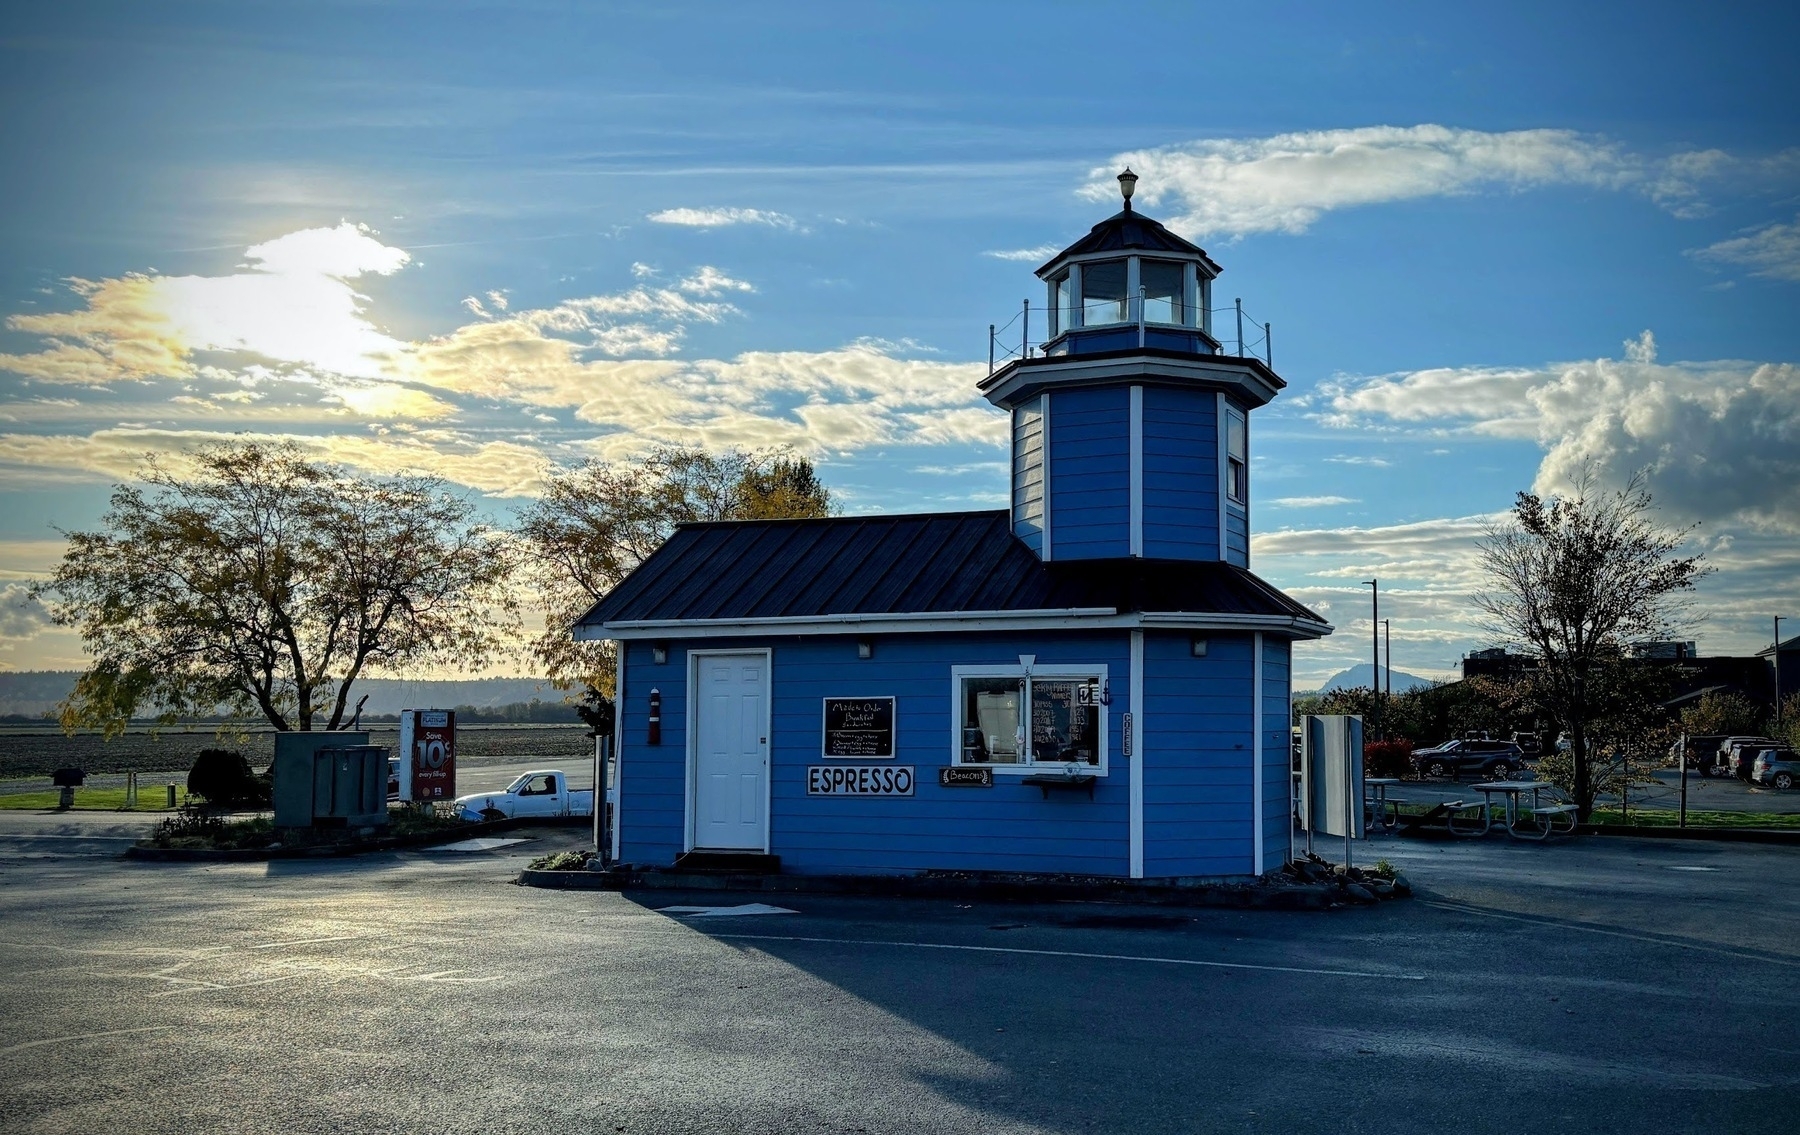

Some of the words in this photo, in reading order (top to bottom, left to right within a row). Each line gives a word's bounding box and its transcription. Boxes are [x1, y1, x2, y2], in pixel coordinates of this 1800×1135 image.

[426, 731, 442, 740] Save
[419, 771, 433, 779] every
[950, 769, 984, 780] Beacons
[809, 768, 912, 793] ESPRESSO
